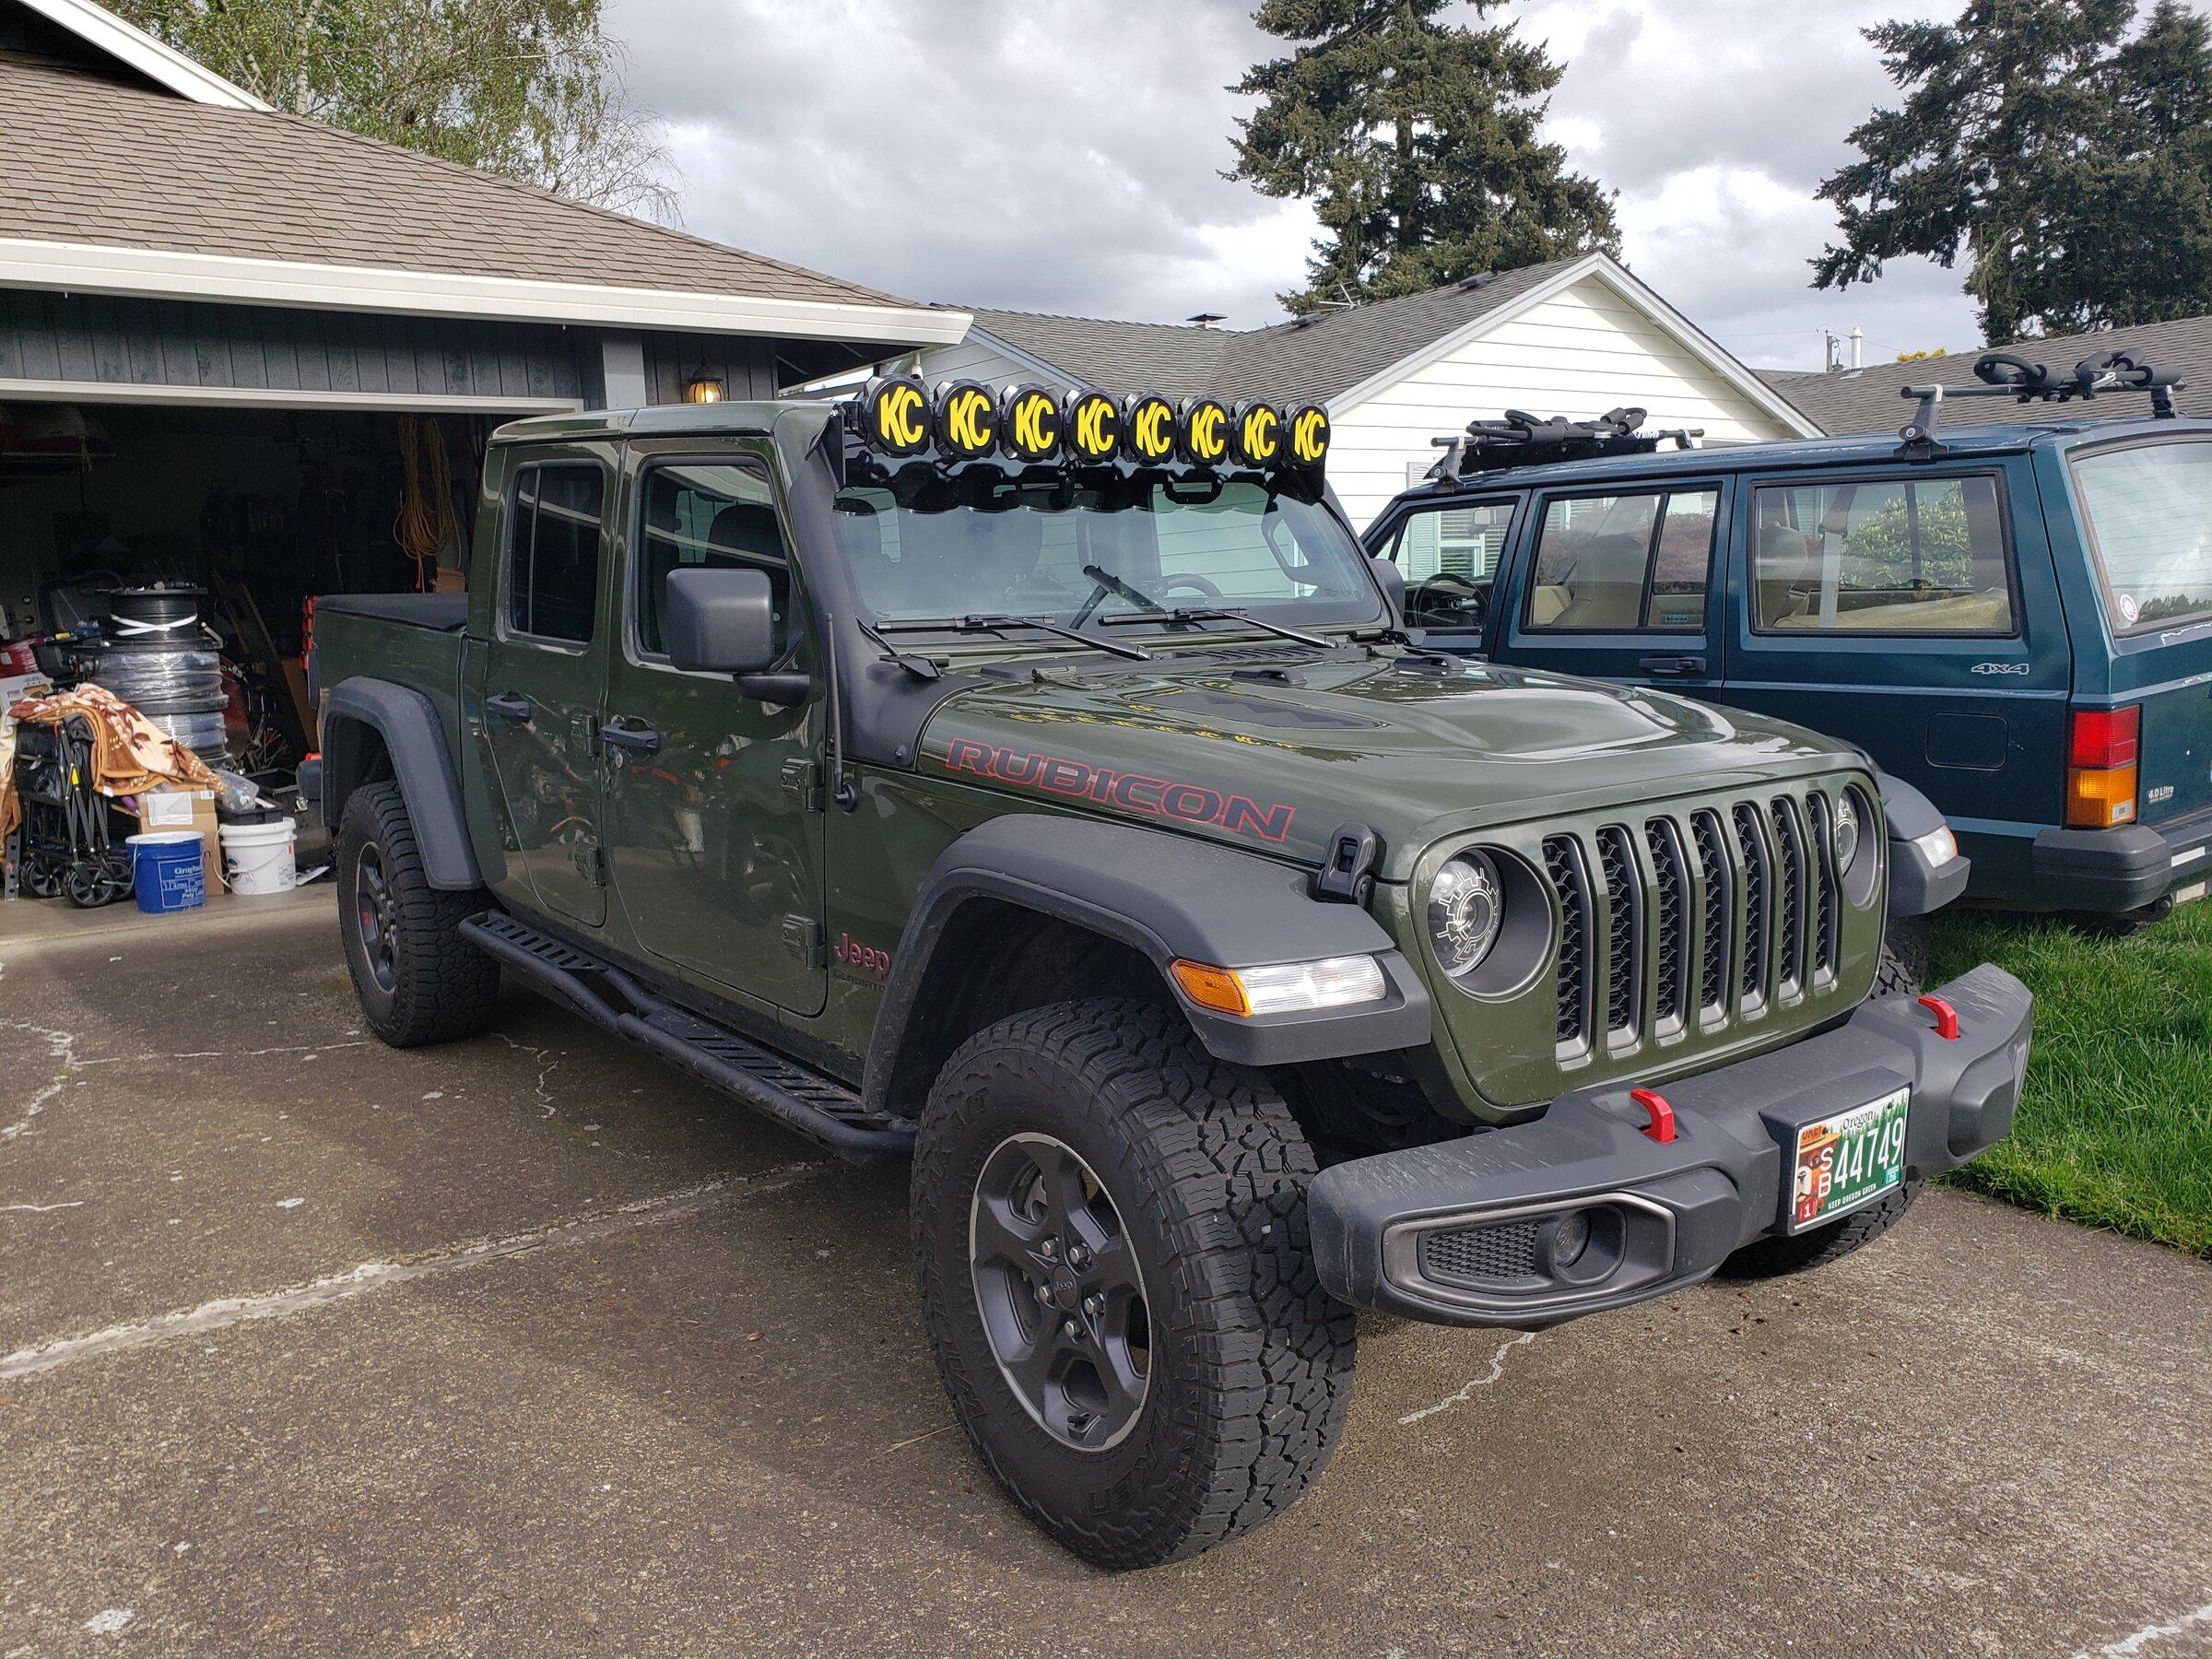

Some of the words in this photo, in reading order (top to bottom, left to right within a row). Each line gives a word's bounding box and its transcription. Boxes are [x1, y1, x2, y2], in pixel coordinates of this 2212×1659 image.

[880, 386, 923, 446] KC
[950, 391, 990, 449] KC
[1016, 394, 1053, 452] KC
[1077, 399, 1113, 453] KC
[1136, 402, 1171, 455] KC
[1192, 406, 1224, 458] KC
[1244, 408, 1276, 458] KC
[1295, 411, 1324, 461] KC
[945, 737, 1296, 842] RUBICON
[833, 931, 891, 981] Jeep
[1843, 1111, 1873, 1130] Oregon
[1834, 1117, 1904, 1189] 44749
[1828, 1198, 1841, 1210] KEEP
